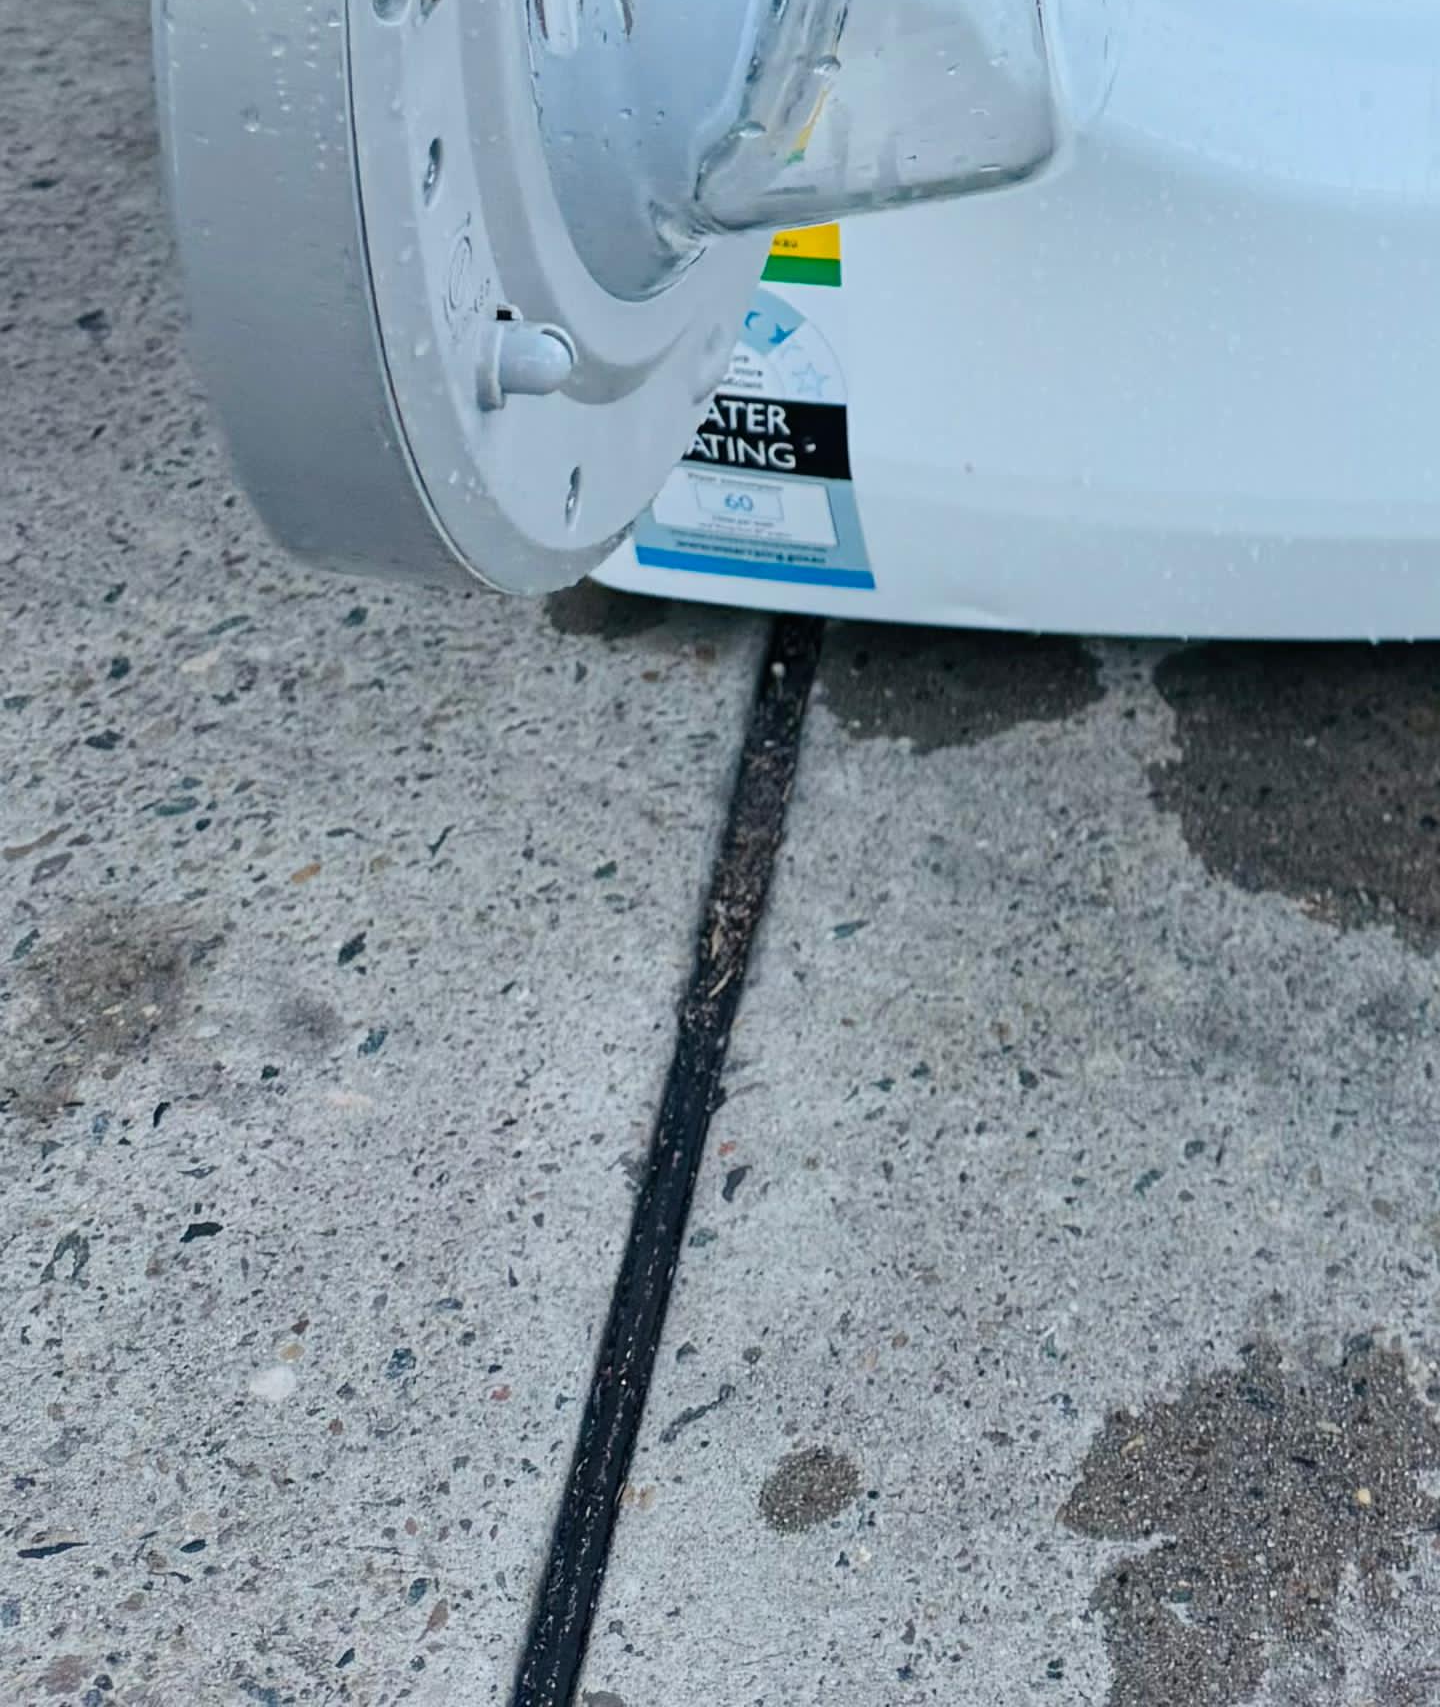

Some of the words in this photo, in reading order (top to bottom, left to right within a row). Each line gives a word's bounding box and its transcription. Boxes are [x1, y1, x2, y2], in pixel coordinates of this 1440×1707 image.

[700, 399, 791, 435] ATER
[685, 432, 796, 470] ATING
[725, 492, 754, 512] 60
